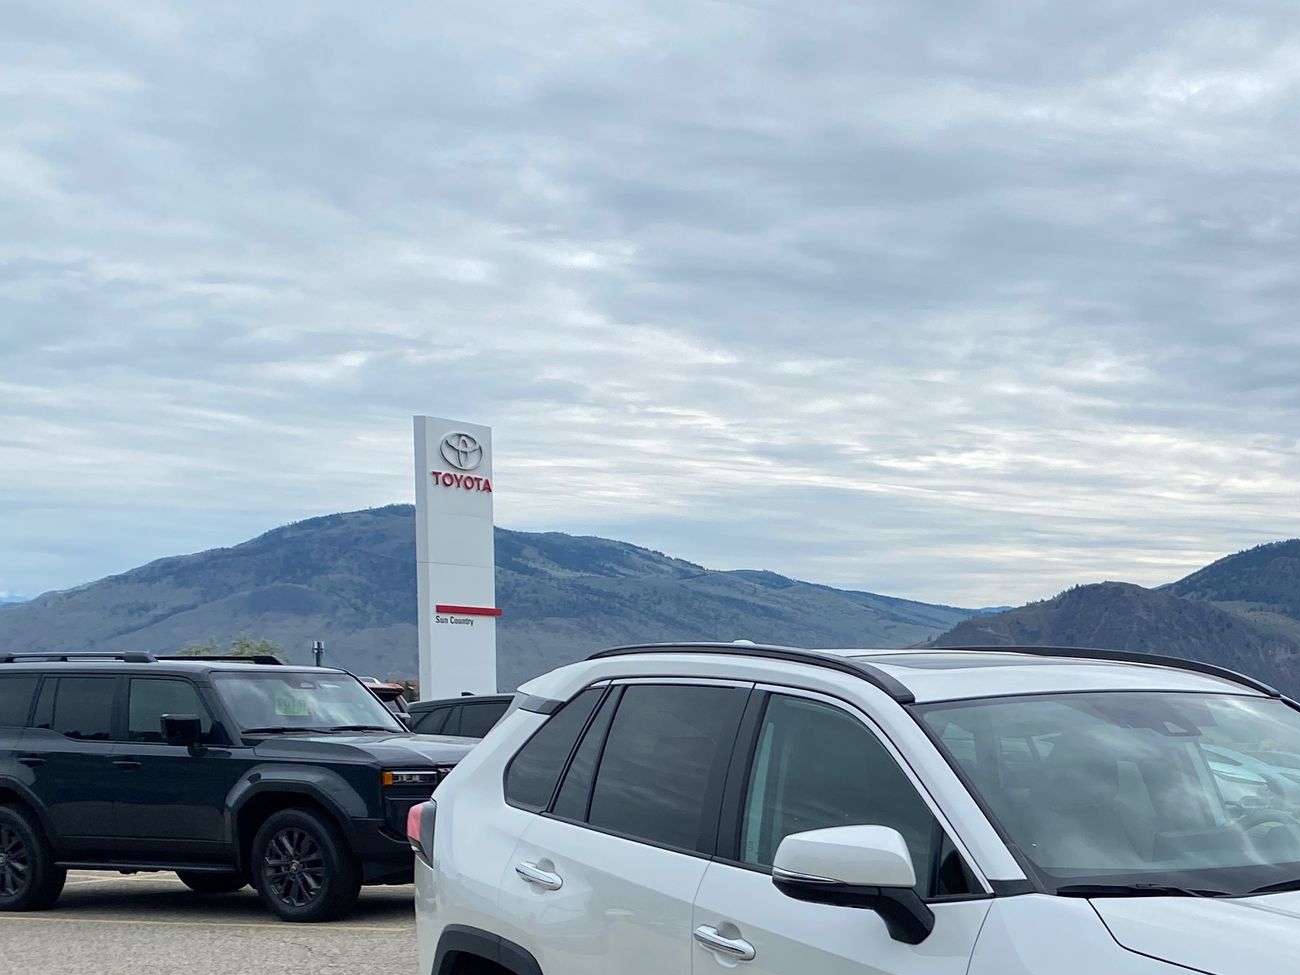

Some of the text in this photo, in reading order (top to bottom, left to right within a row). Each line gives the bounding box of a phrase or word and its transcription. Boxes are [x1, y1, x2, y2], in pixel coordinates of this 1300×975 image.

[431, 471, 492, 493] TOYOTA
[435, 615, 474, 627] Sun Country
